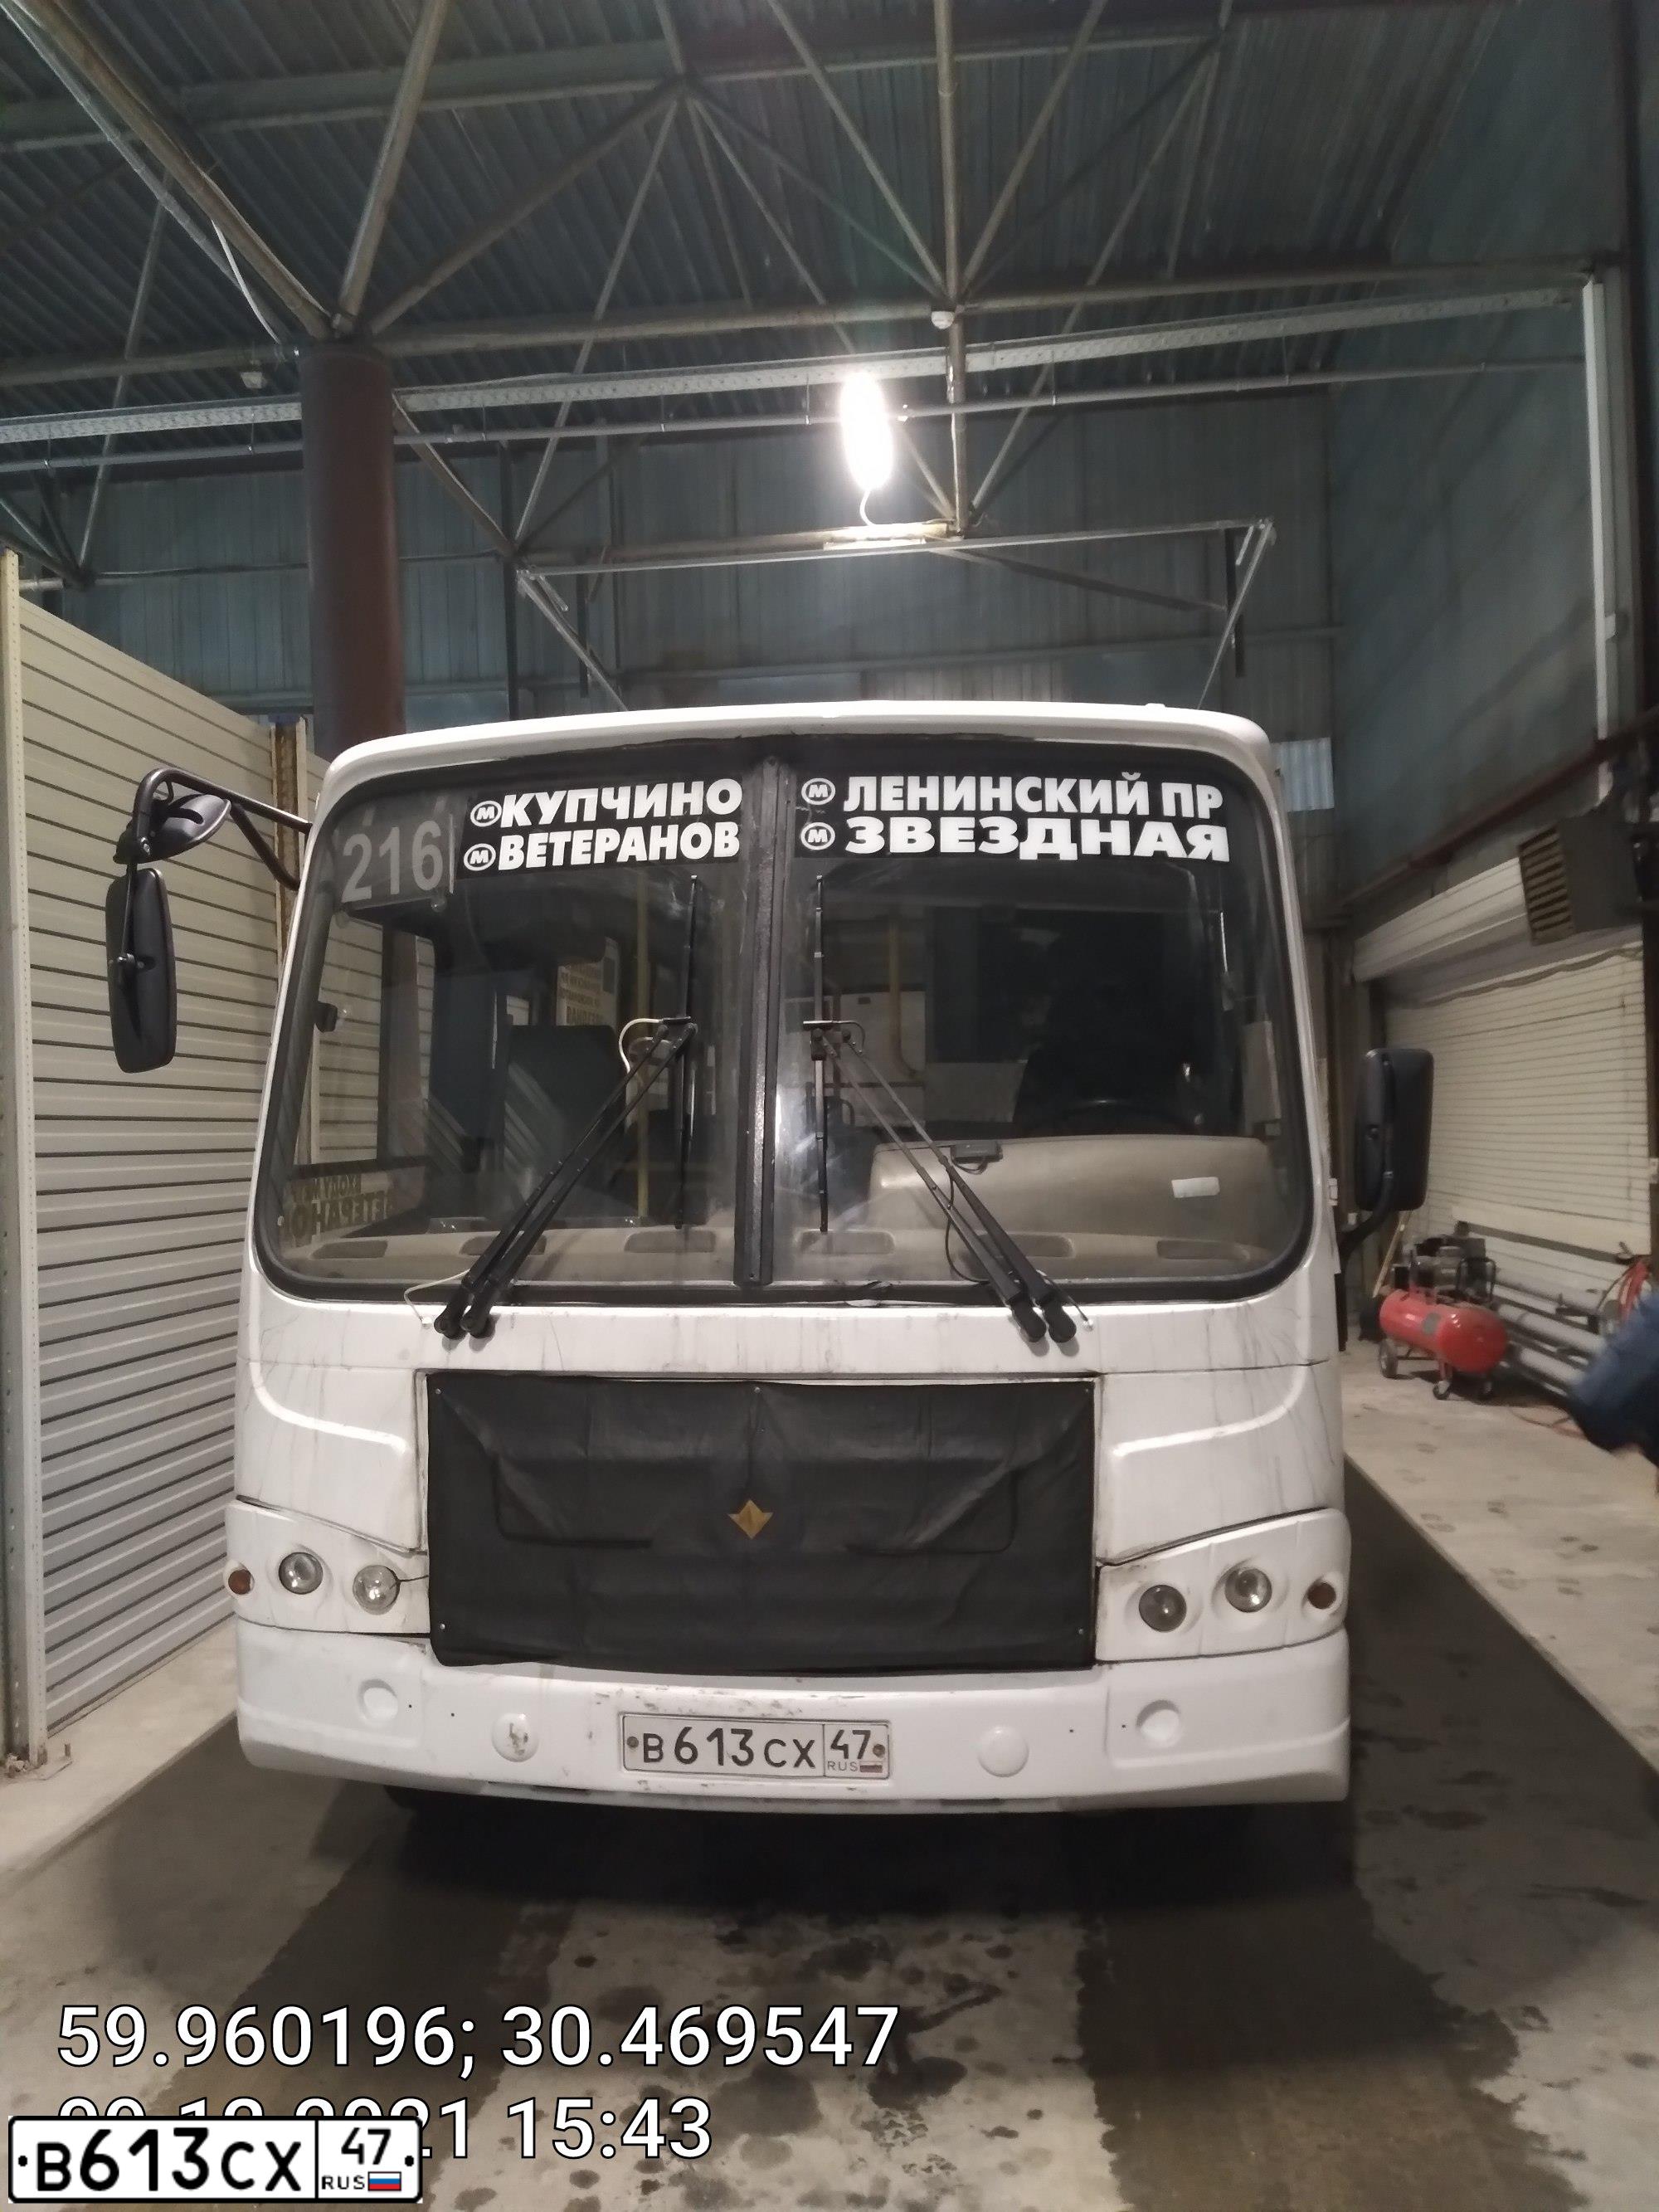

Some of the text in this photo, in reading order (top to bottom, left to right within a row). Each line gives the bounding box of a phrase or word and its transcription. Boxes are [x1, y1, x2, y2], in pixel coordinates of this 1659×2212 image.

[499, 778, 743, 828] КУПЧИНО
[843, 772, 1150, 816] ЛЕНИНСКИЙ
[1161, 782, 1224, 820] ПР
[341, 820, 444, 904] 216
[497, 821, 741, 871] ВЕТЕРАНОВ
[844, 816, 1230, 863] ЗВЕЗДНАЯ
[643, 1726, 872, 1769] В613СХ 47
[827, 1761, 858, 1772] RUS
